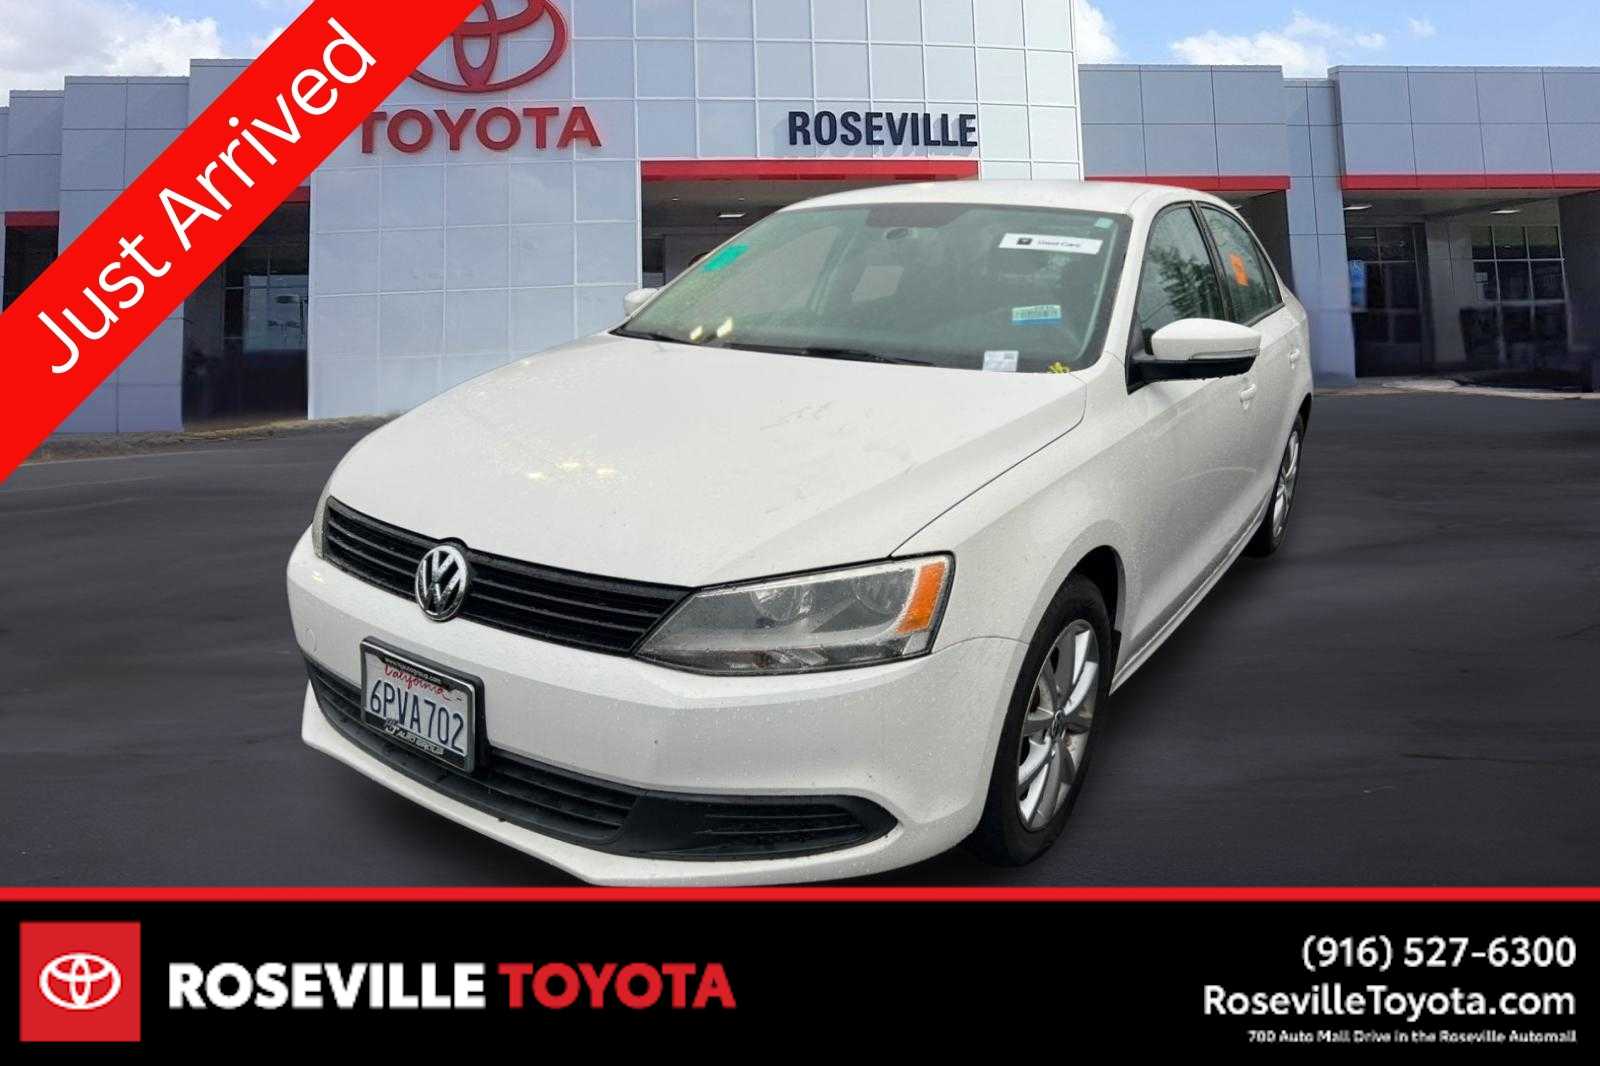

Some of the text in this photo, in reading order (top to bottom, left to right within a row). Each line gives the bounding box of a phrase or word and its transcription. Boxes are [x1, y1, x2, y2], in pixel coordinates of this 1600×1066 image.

[361, 106, 602, 154] TOYOTA
[787, 110, 978, 147] ROSEVILLE
[369, 679, 465, 754] 6PVA702
